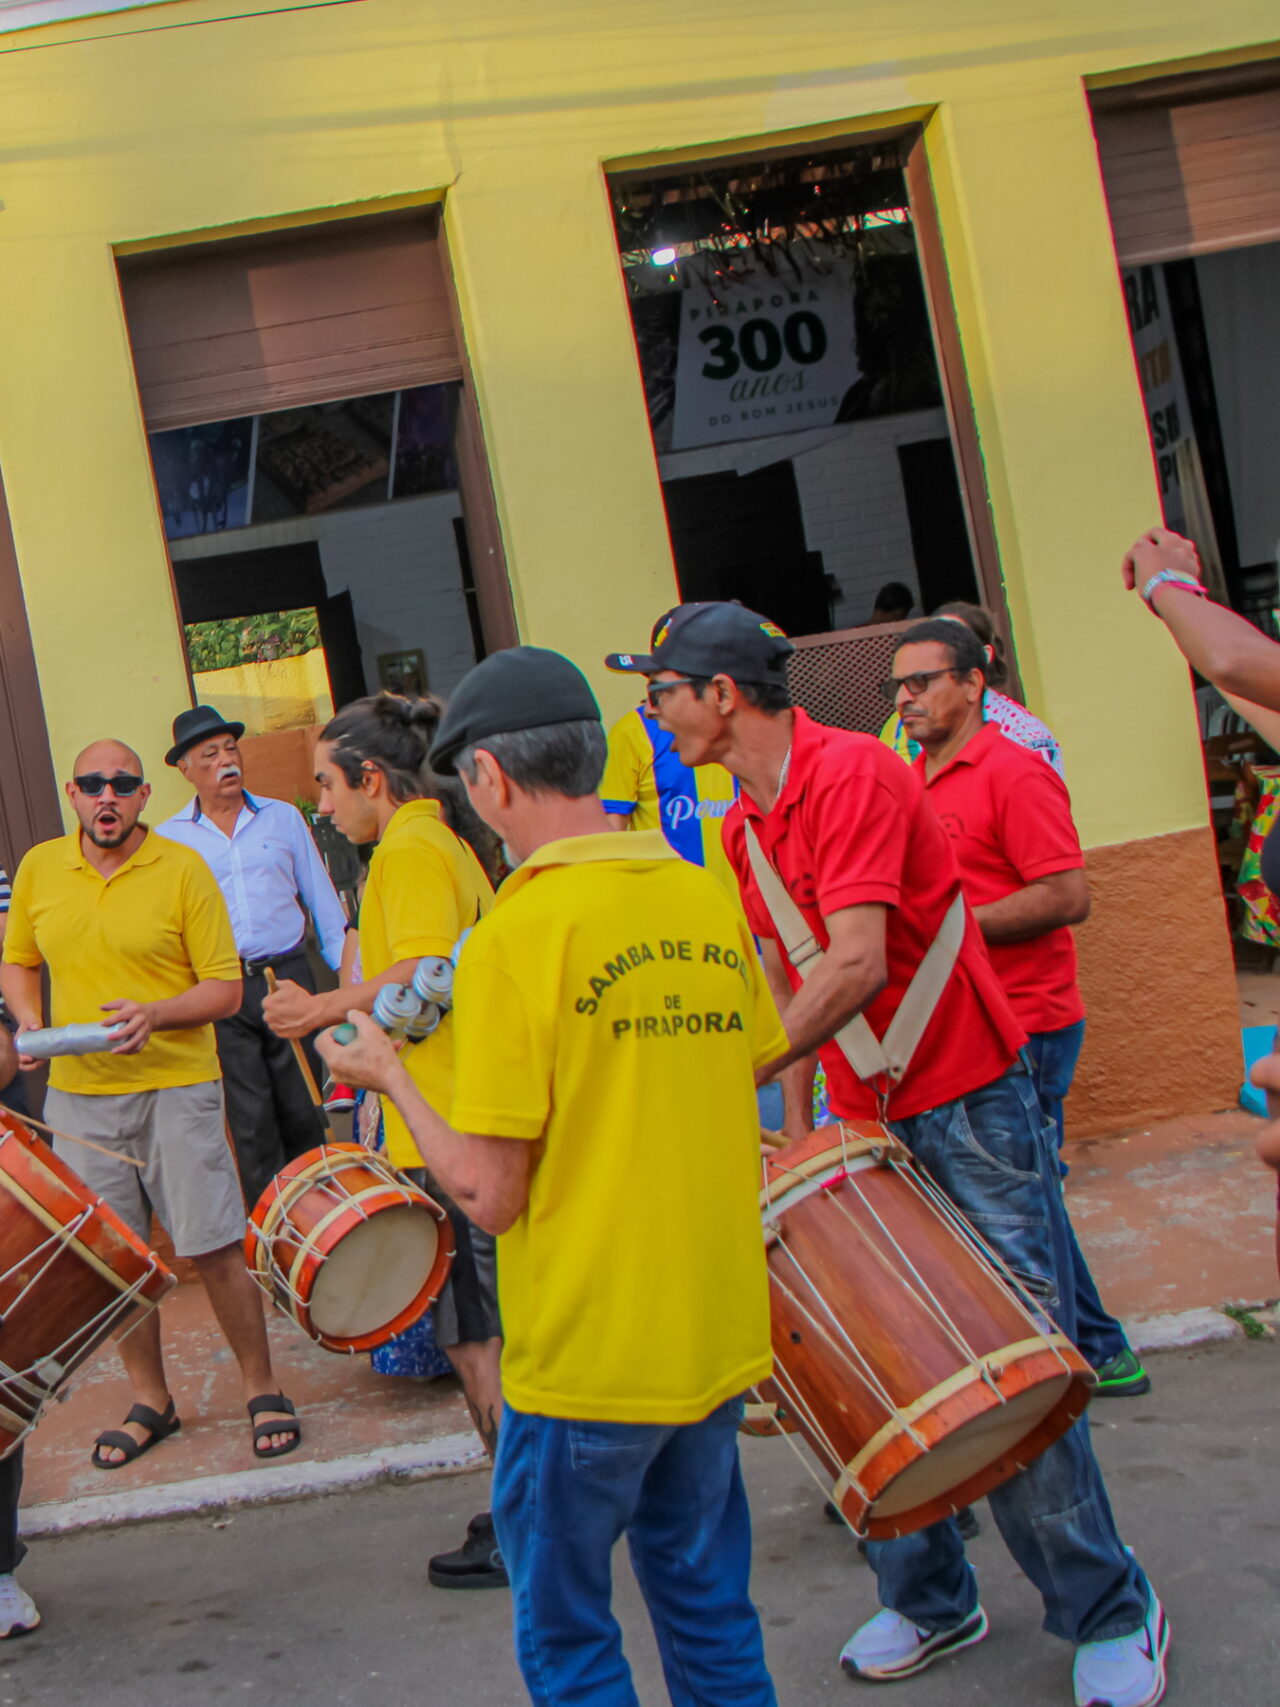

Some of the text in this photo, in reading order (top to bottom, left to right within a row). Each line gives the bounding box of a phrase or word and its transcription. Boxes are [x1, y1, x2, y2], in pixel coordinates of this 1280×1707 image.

[689, 288, 820, 322] PIRAPORA
[698, 310, 827, 380] 300
[730, 369, 809, 402] anos
[708, 396, 840, 426] DO BOM JESUS
[665, 795, 737, 831] Peru
[574, 942, 654, 1016] SAMBA
[660, 939, 692, 961] DE
[664, 994, 682, 1010] DE
[612, 1011, 744, 1040] PIRAPORA
